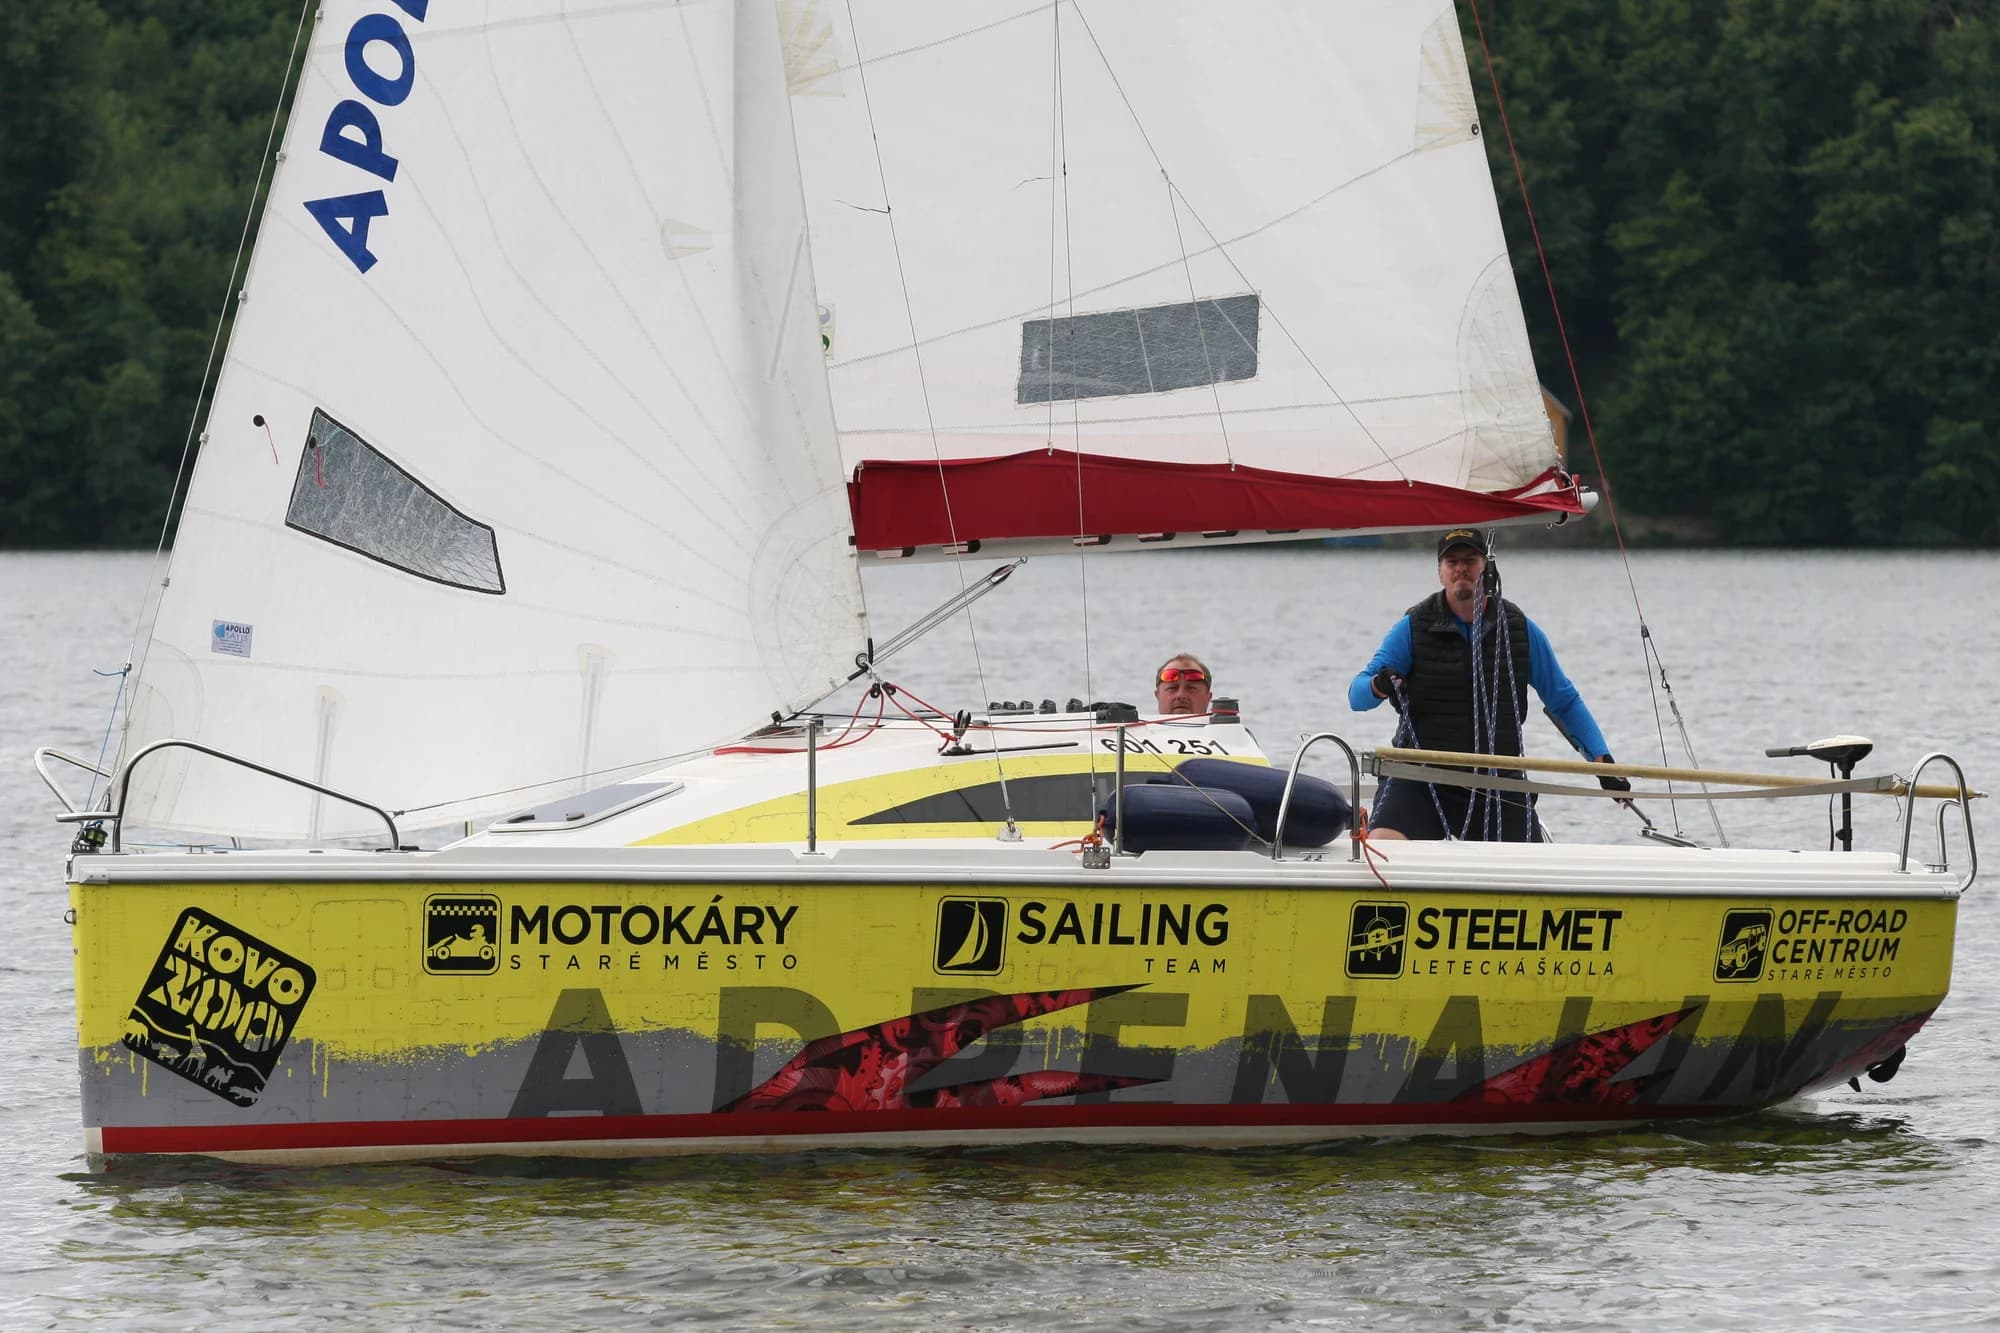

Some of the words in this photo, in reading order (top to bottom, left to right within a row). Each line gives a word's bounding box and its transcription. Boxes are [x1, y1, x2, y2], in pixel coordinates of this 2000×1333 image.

[225, 623, 250, 634] APOLLO
[1101, 739, 1163, 754] 601
[1168, 739, 1230, 756] 251
[510, 895, 799, 946] MOTOKÁRY
[1016, 902, 1229, 946] SAILING
[1414, 907, 1623, 951] STEELMET
[1778, 909, 1908, 934] OFF-ROAD
[173, 914, 305, 1006] KOVO
[510, 951, 641, 970] STARÉ
[664, 951, 798, 970] MĚSTO
[1772, 938, 1901, 964] CENTRUM
[1144, 958, 1227, 974] TEAM
[1412, 957, 1525, 975] LETECKÁ
[1537, 957, 1614, 976] ŠKOLA
[1767, 966, 1825, 981] STARÉ
